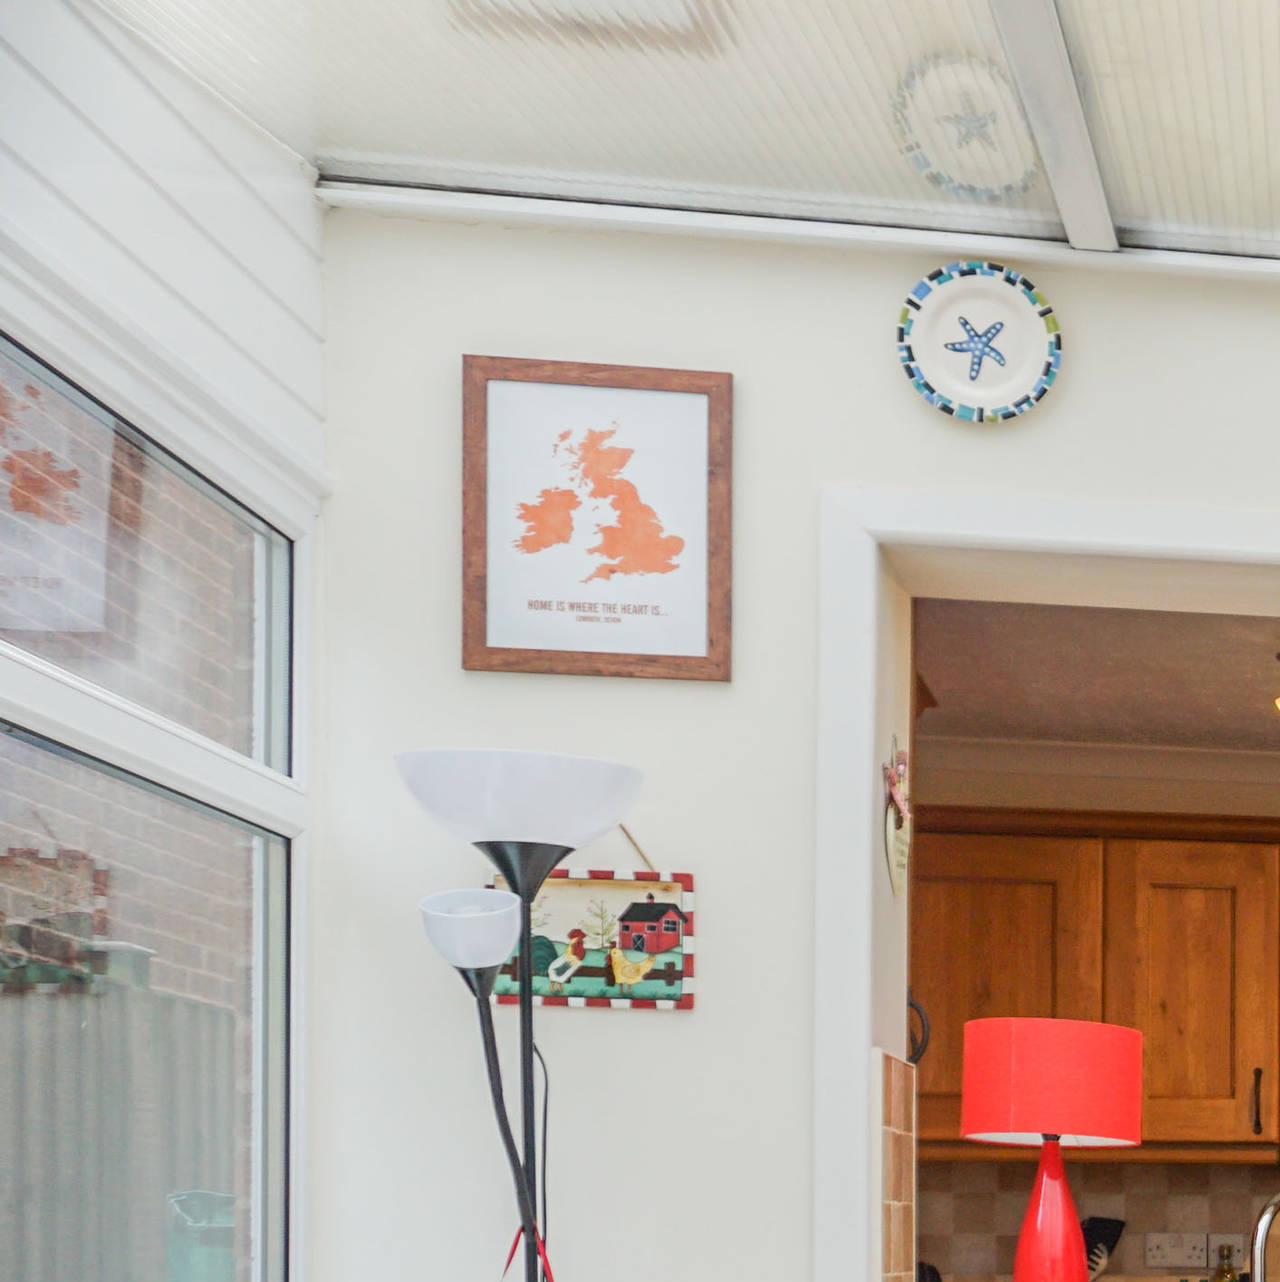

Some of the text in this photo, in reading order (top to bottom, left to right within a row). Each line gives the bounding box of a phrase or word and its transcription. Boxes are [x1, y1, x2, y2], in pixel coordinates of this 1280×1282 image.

[528, 599, 553, 611] HOME
[556, 601, 565, 611] IS
[568, 602, 599, 613] WHERE
[602, 603, 617, 614] THE
[620, 604, 648, 615] HEART
